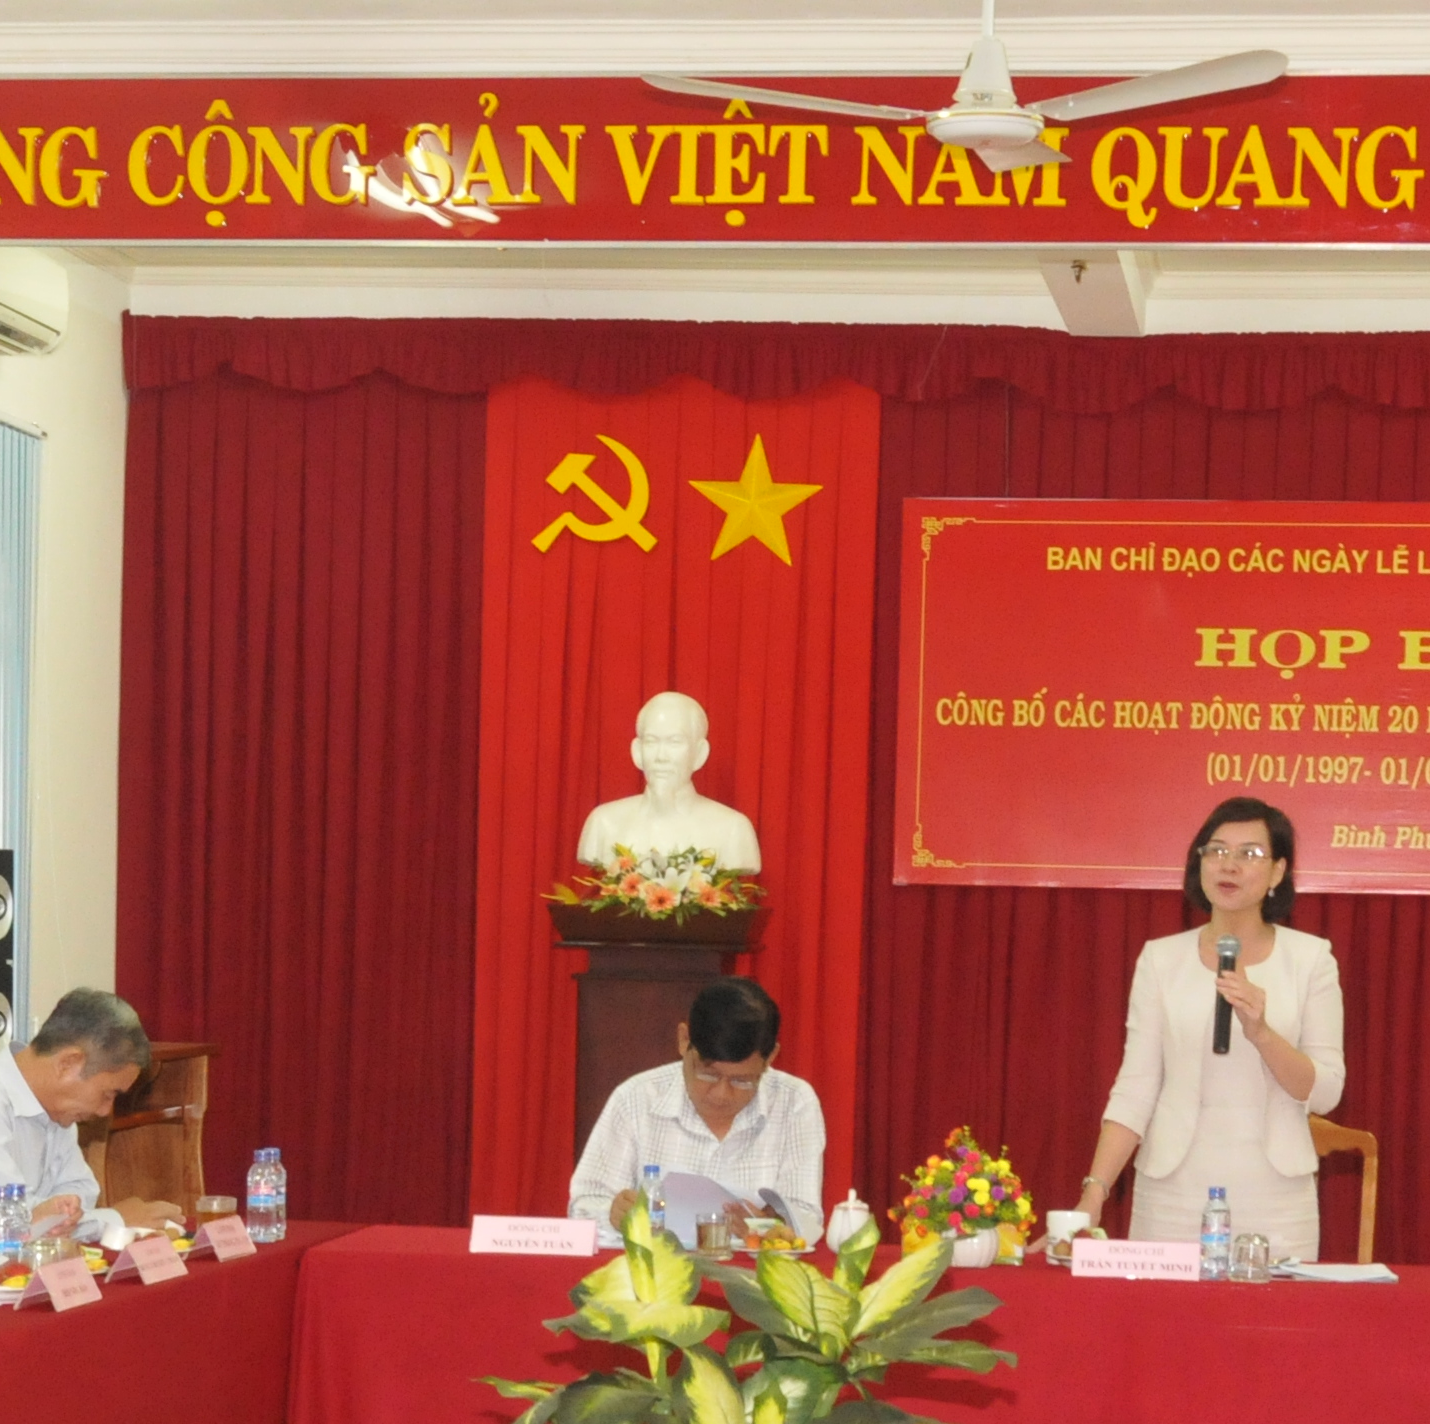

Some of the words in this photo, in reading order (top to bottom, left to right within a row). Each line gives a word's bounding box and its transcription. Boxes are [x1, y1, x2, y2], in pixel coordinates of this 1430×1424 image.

[128, 99, 375, 228] CỘNG
[401, 92, 587, 206] SẢN
[605, 98, 828, 227] VIỆT
[852, 125, 1070, 207] NAM
[1091, 125, 1425, 229] QUANG
[1047, 547, 1102, 570] BAN
[1111, 542, 1155, 571] CHỈ
[1162, 548, 1220, 577] ĐẠO
[1228, 543, 1284, 572] CÁC
[1293, 543, 1369, 573] NGÀY
[1377, 545, 1409, 574] LỄ
[1195, 628, 1370, 679] HỌP
[936, 692, 1004, 726] CÔNG
[1012, 688, 1047, 727] BỐ
[1055, 693, 1105, 728] CÁC
[1113, 701, 1183, 734] HOẠT
[1190, 696, 1261, 736] ĐỘNG
[1269, 694, 1305, 731] KỶ
[1313, 698, 1380, 738] NIỆM
[1388, 706, 1419, 733] 20
[1331, 825, 1386, 849] Bình
